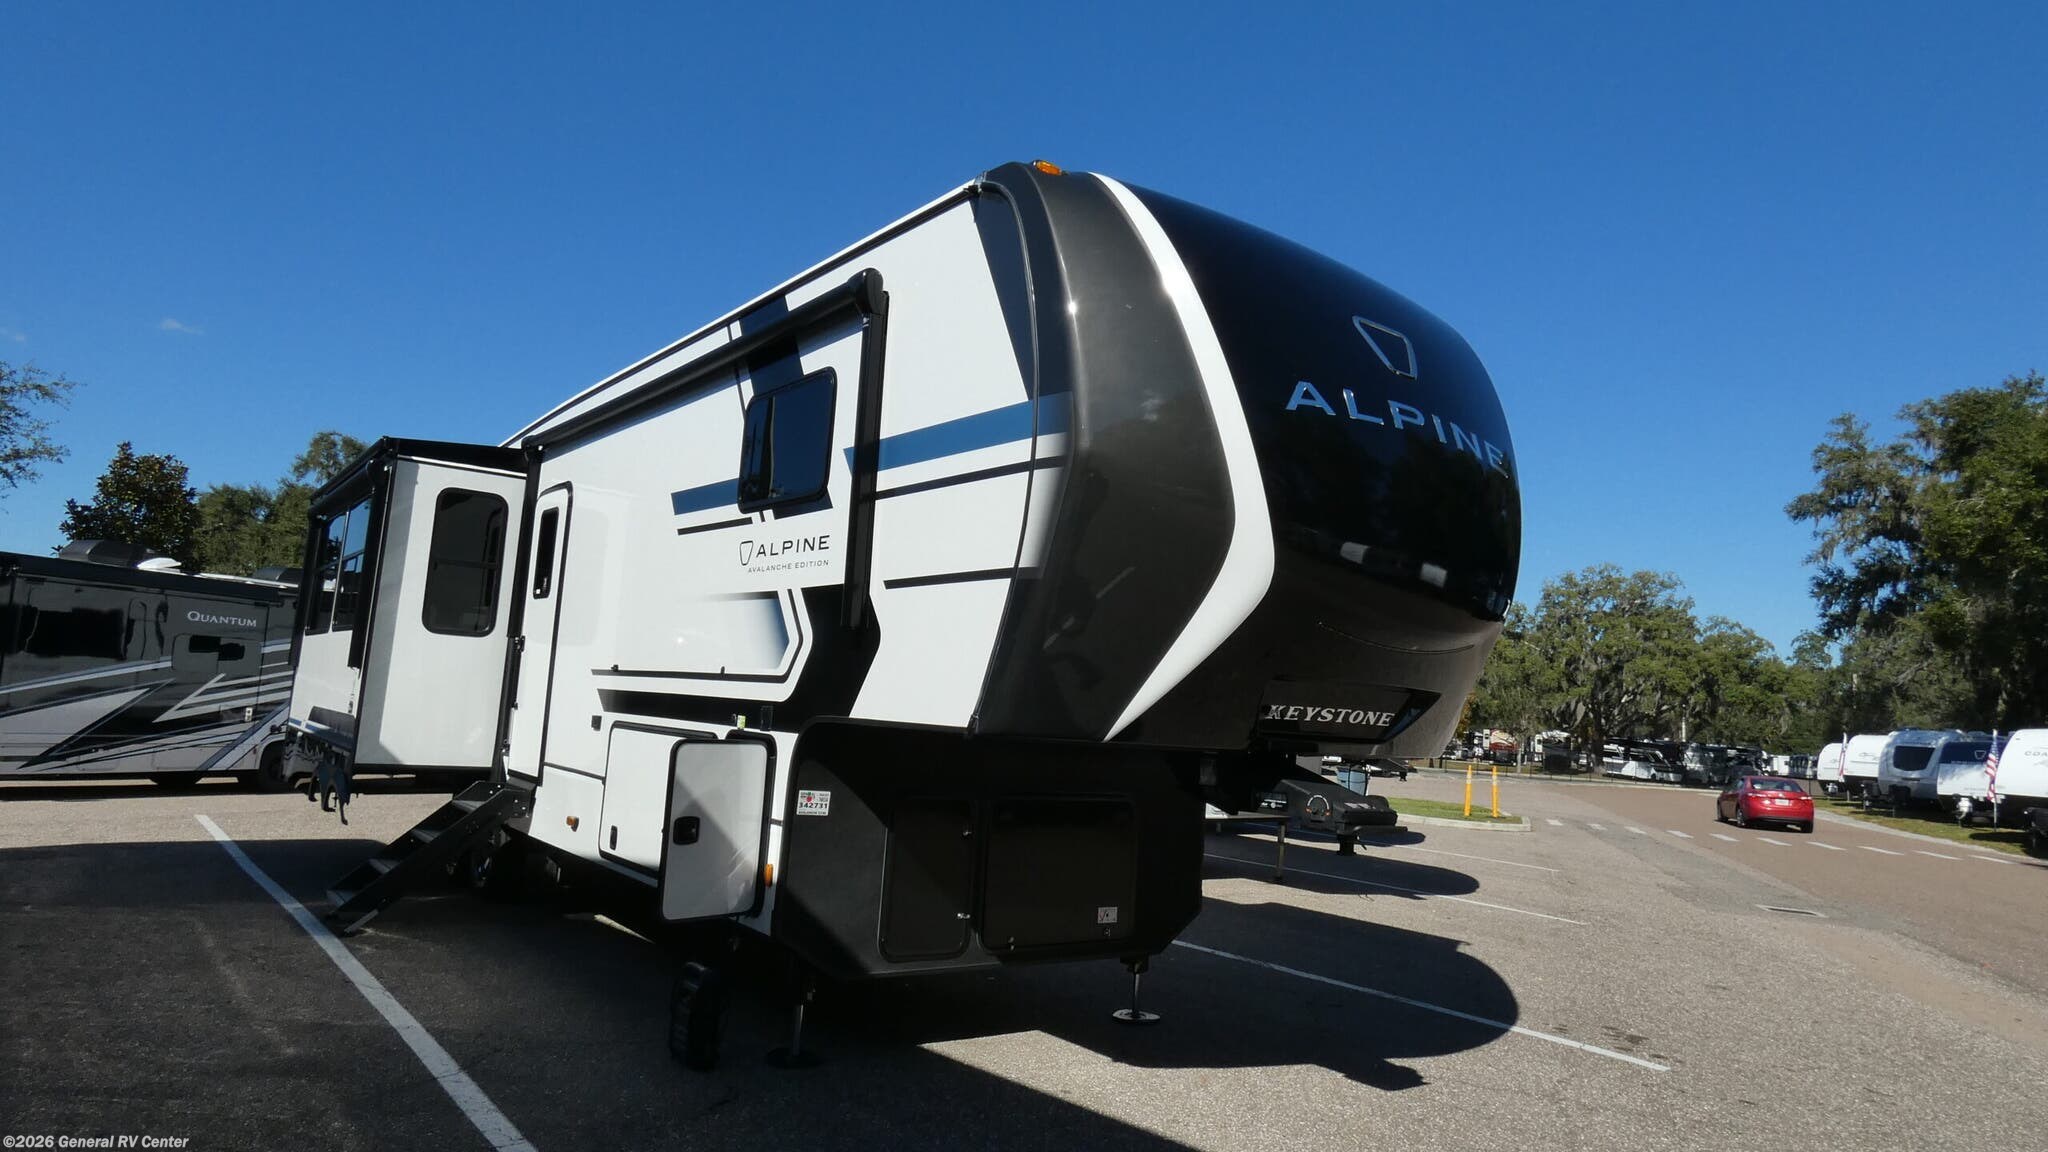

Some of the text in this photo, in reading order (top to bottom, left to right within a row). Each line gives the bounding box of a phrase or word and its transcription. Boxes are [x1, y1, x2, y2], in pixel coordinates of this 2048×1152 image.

[1285, 380, 1509, 479] ALPINE
[756, 535, 830, 558] ALPINE
[748, 559, 829, 573] AVALANCHE EDITION
[187, 610, 257, 627] QUANTUM
[1264, 704, 1396, 727] KEYSTONE
